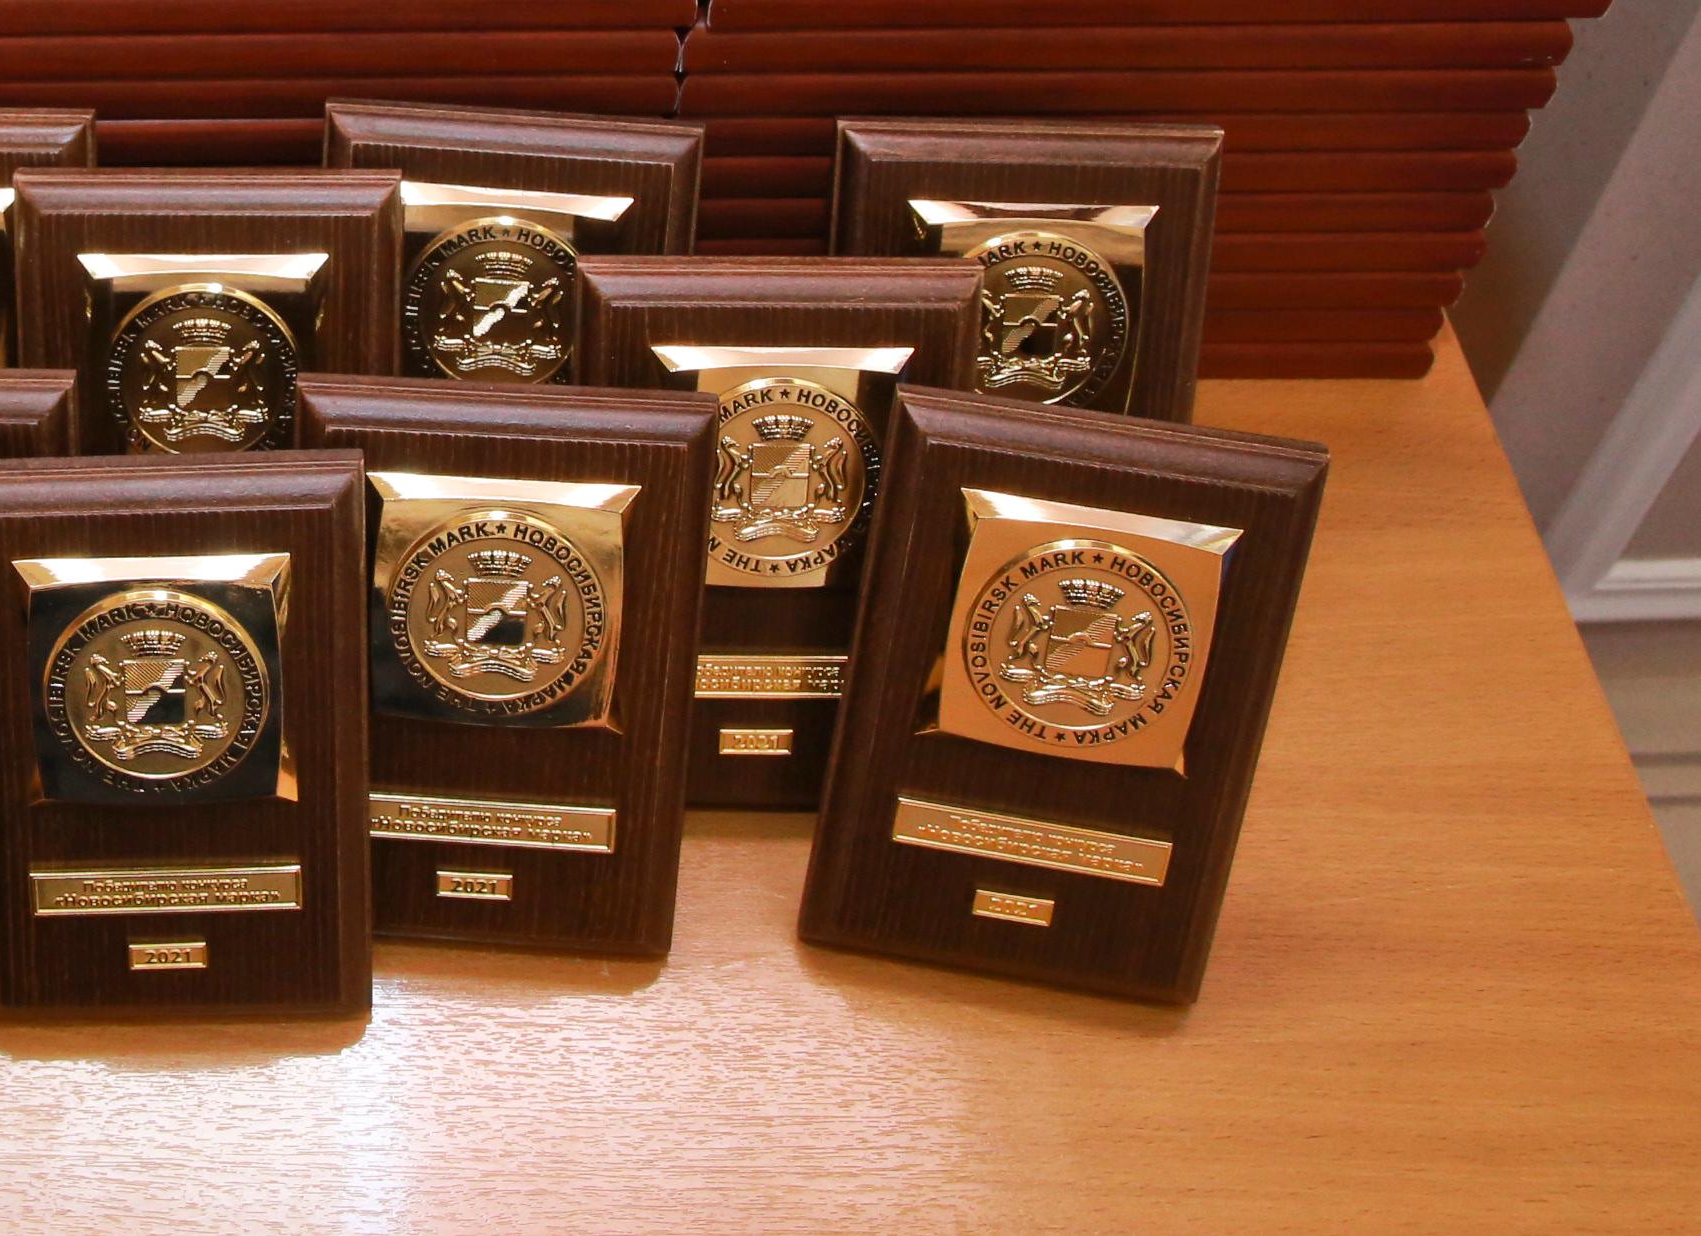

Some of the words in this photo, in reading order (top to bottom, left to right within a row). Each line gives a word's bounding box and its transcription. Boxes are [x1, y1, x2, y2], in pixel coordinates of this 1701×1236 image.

[428, 522, 492, 556] MARK
[722, 548, 761, 573] THE
[1019, 551, 1086, 579] MARK
[513, 524, 604, 676] НОВОСИБИРСКАЯ
[970, 575, 1019, 711] NOVOSIBIRSK
[1110, 556, 1191, 715] НОВОСИБИРСКАЯ
[1006, 709, 1048, 740] THE
[1073, 712, 1148, 745] МАРКА
[734, 734, 779, 749] 2021
[399, 803, 492, 822] Победителю
[82, 879, 177, 893] Победителю
[181, 878, 248, 892] конкурса
[451, 877, 498, 894] 2021
[54, 892, 209, 908] «Новосибирская
[214, 891, 281, 905] марка»
[146, 948, 192, 964] 2021
